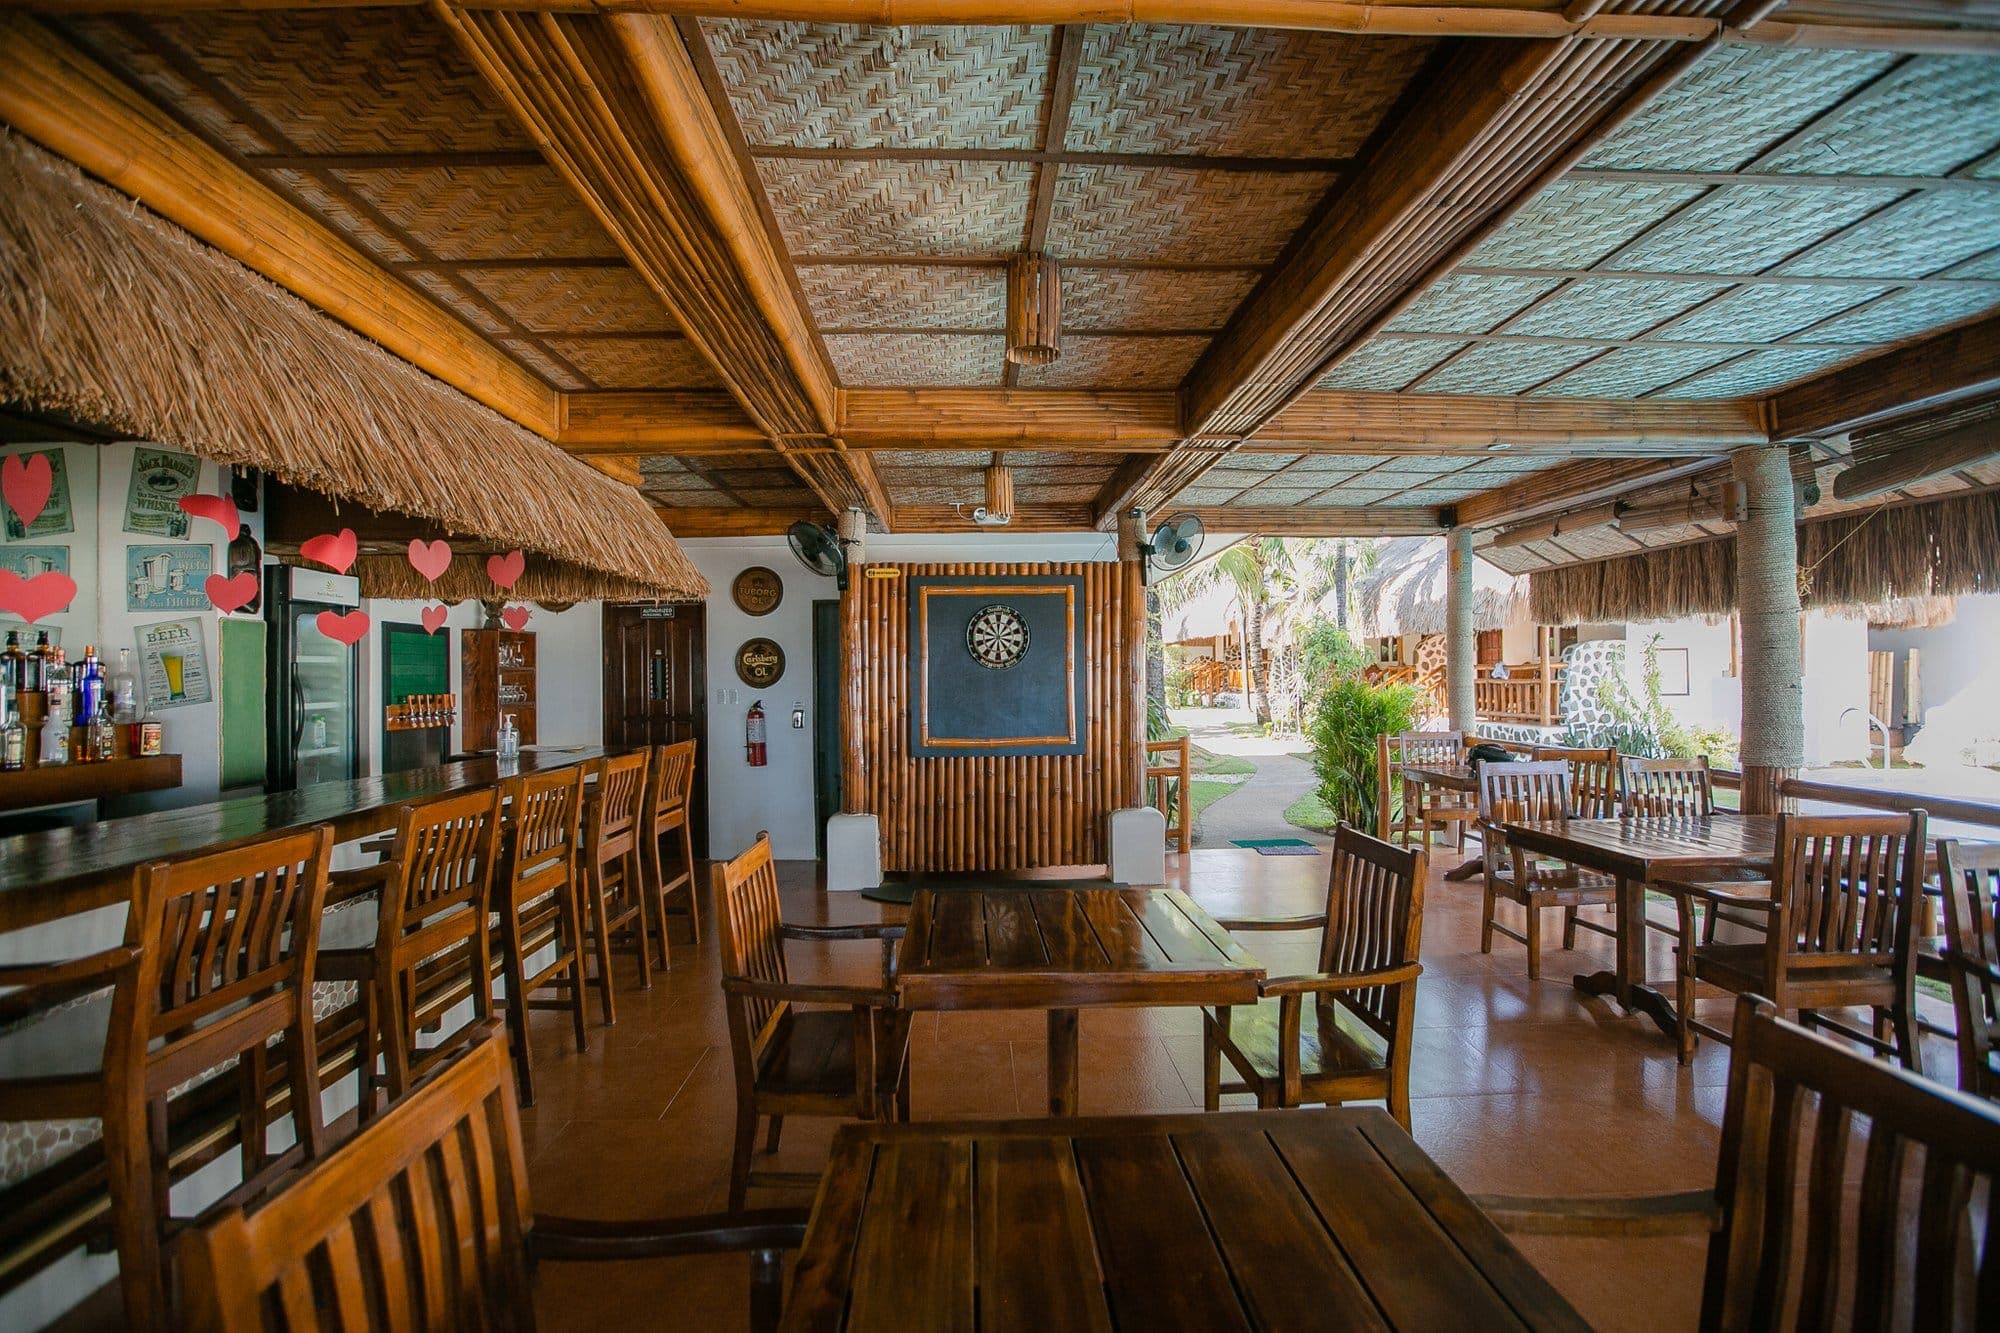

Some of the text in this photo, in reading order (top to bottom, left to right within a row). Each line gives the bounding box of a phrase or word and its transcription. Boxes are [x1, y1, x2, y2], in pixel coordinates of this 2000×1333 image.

[138, 455, 196, 479] JACK DANIEL'S
[740, 587, 777, 597] TUBORG
[146, 628, 190, 643] BEER
[743, 652, 778, 666] Carlsberg
